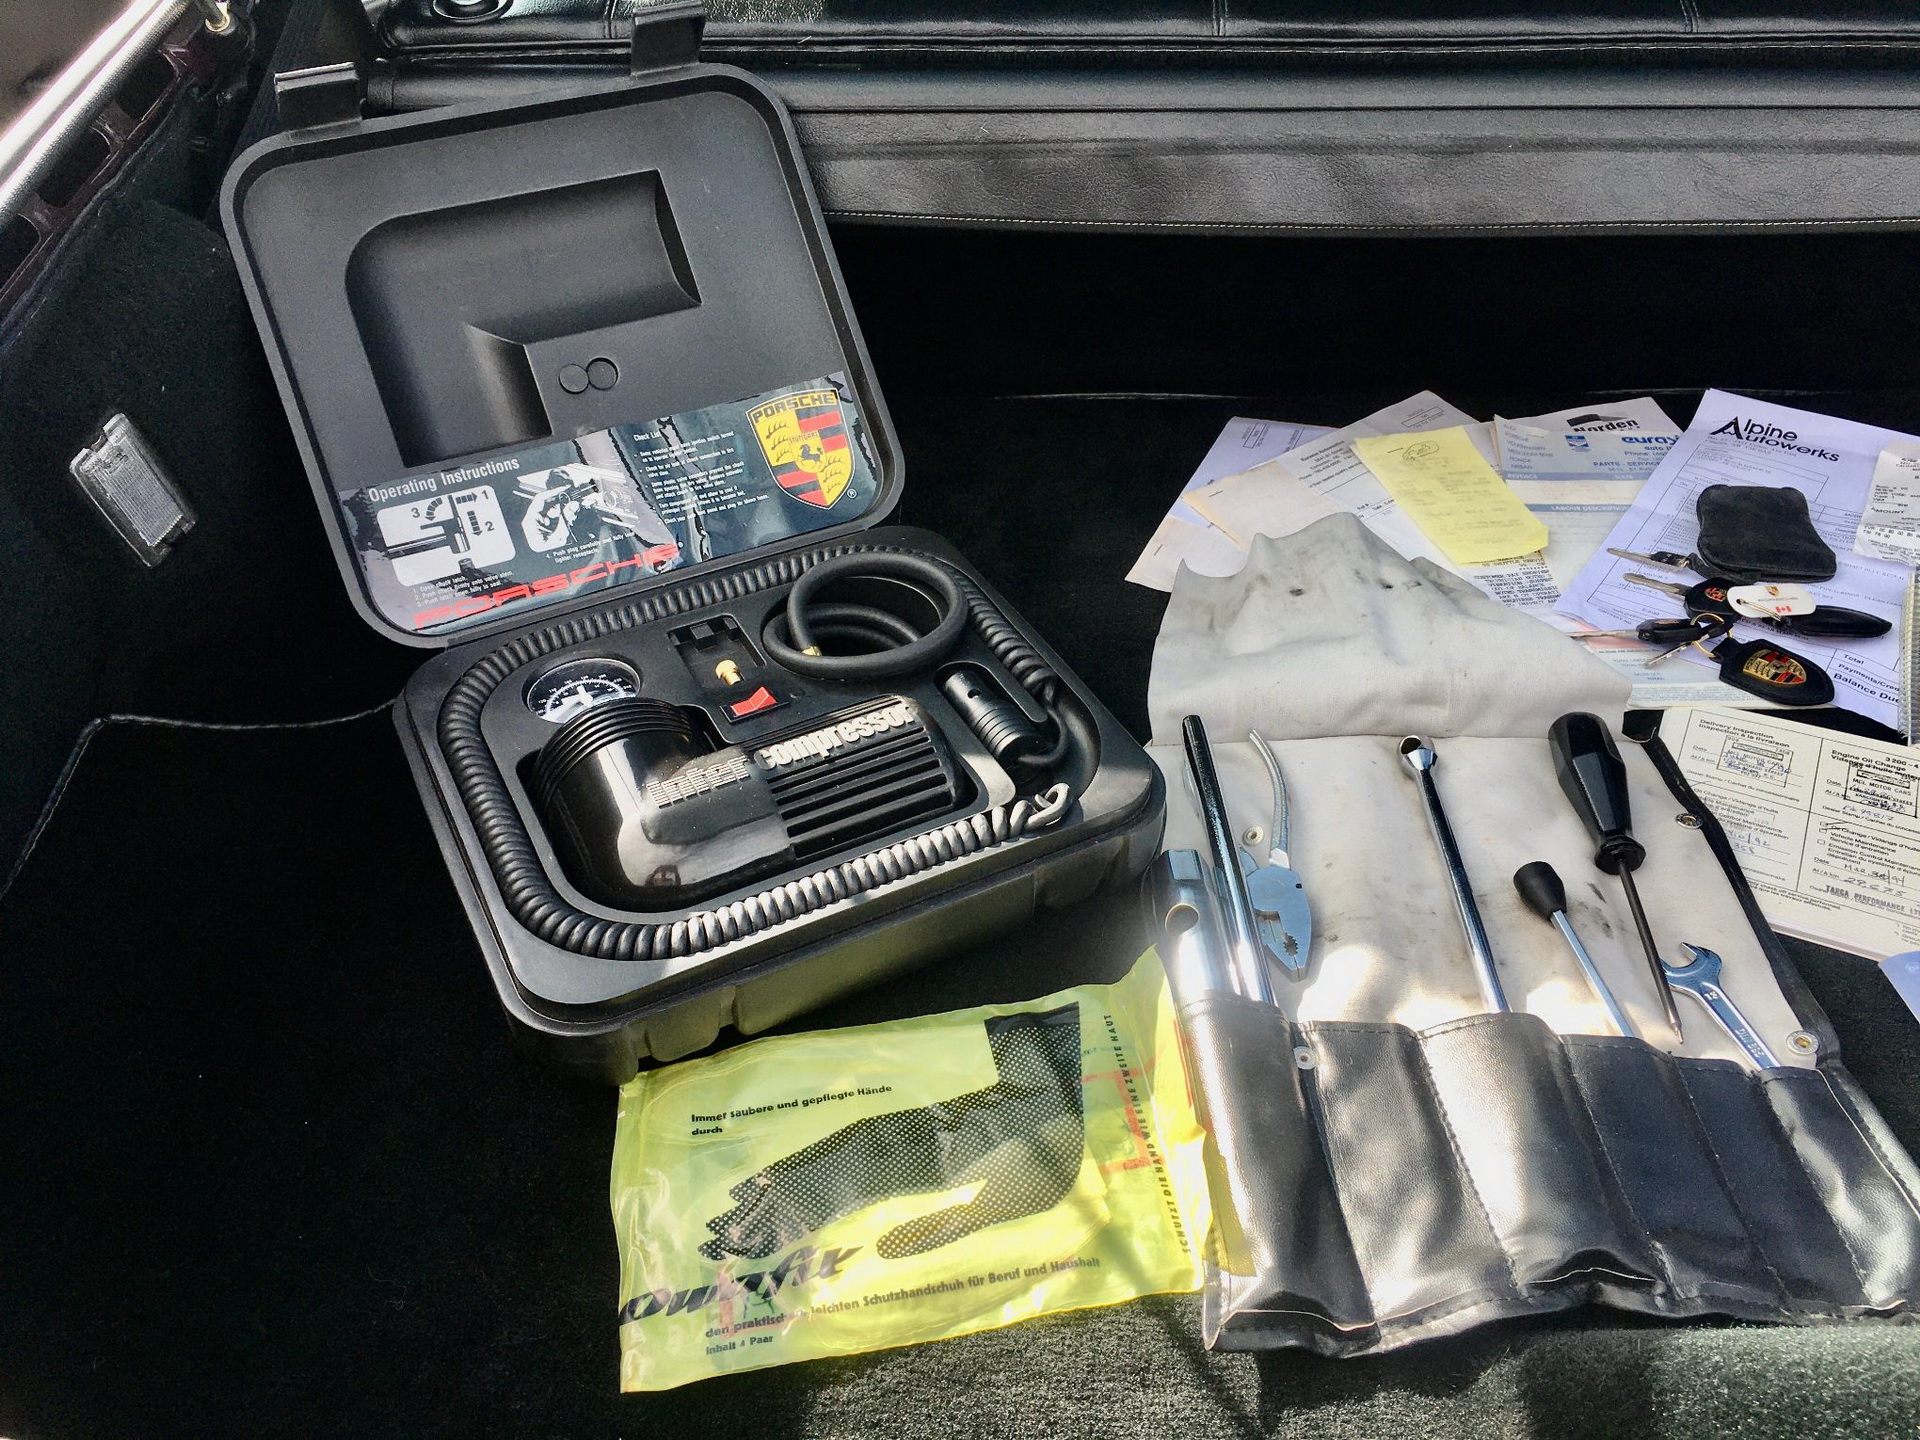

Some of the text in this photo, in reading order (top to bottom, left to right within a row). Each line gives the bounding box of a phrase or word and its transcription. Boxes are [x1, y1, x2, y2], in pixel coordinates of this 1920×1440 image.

[752, 394, 836, 424] PORSCHE
[633, 433, 649, 441] Check
[1710, 416, 1797, 441] Alpine
[368, 458, 520, 502] Operating Instructions
[482, 490, 489, 499] 1
[411, 508, 420, 518] 3
[485, 521, 494, 531] 2
[412, 542, 681, 629] PORSCHE
[1844, 653, 1864, 665] Total
[1833, 673, 1877, 696] Balance
[753, 704, 914, 771] compressor
[1699, 724, 1739, 736] Inspection
[1755, 737, 1790, 748] livraison
[1700, 719, 1774, 739] Delivery Inspection
[1832, 750, 1860, 760] Engine
[1875, 761, 1906, 772] Change
[1869, 782, 1891, 791] MOTOR
[1894, 787, 1912, 796] CARS
[1830, 832, 1896, 853] Vehicle Maintenance
[1830, 836, 1889, 856] Service d'entretien
[1841, 828, 1867, 838] Change
[1871, 835, 1897, 847] Vidange
[1828, 848, 1857, 859] Entretien
[1829, 843, 1857, 855] Emission
[1860, 851, 1881, 860] Control
[1826, 885, 1905, 912] TARGA PERFORMANCE
[1103, 1014, 1119, 1042] HAUT
[1113, 1045, 1134, 1086] ZWEITE
[692, 1085, 892, 1123] Immer saubere und gepflegte Hände
[1128, 1088, 1143, 1117] EINE
[692, 1127, 723, 1136] durch
[1137, 1118, 1151, 1141] WIE
[1147, 1143, 1164, 1174] HAND
[1158, 1175, 1174, 1197] DIE
[706, 1326, 729, 1337] den
[811, 1301, 860, 1316] leichten
[863, 1278, 964, 1307] Schutzhandschuh
[968, 1276, 984, 1288] für
[989, 1268, 1020, 1283] Beruf
[1024, 1263, 1047, 1277] und
[1050, 1257, 1100, 1273] Haushalt
[750, 1334, 774, 1346] Paar
